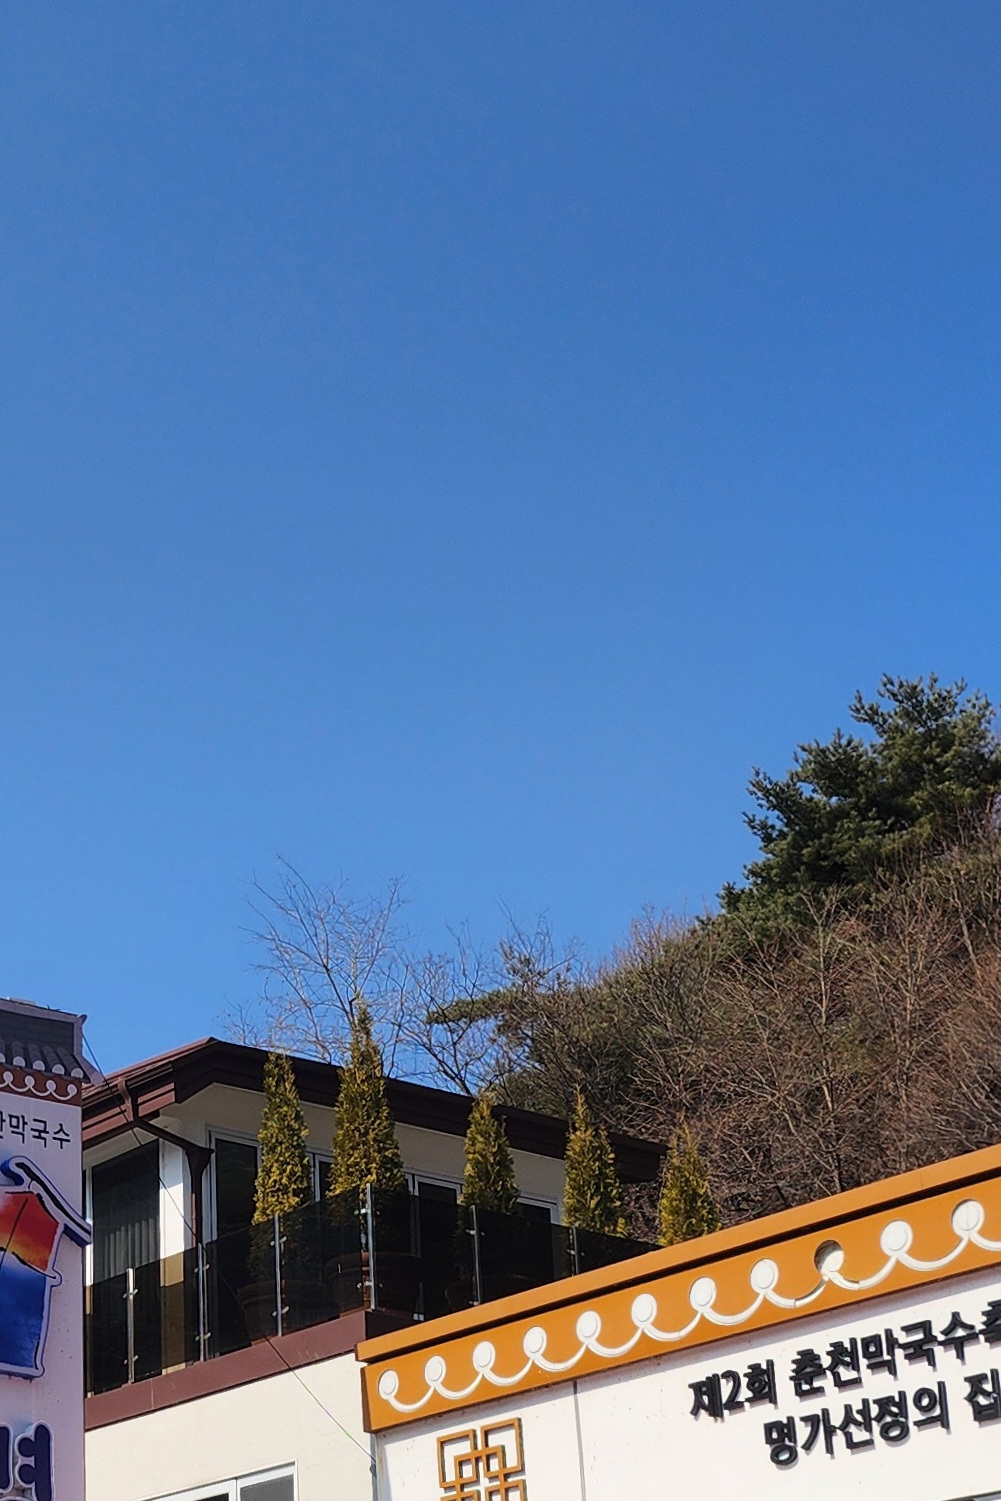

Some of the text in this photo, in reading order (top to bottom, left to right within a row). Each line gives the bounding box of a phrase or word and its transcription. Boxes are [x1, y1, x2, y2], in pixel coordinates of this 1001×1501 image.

[688, 1359, 778, 1420] 제2회
[764, 1369, 1001, 1467] 명가선정의 집
